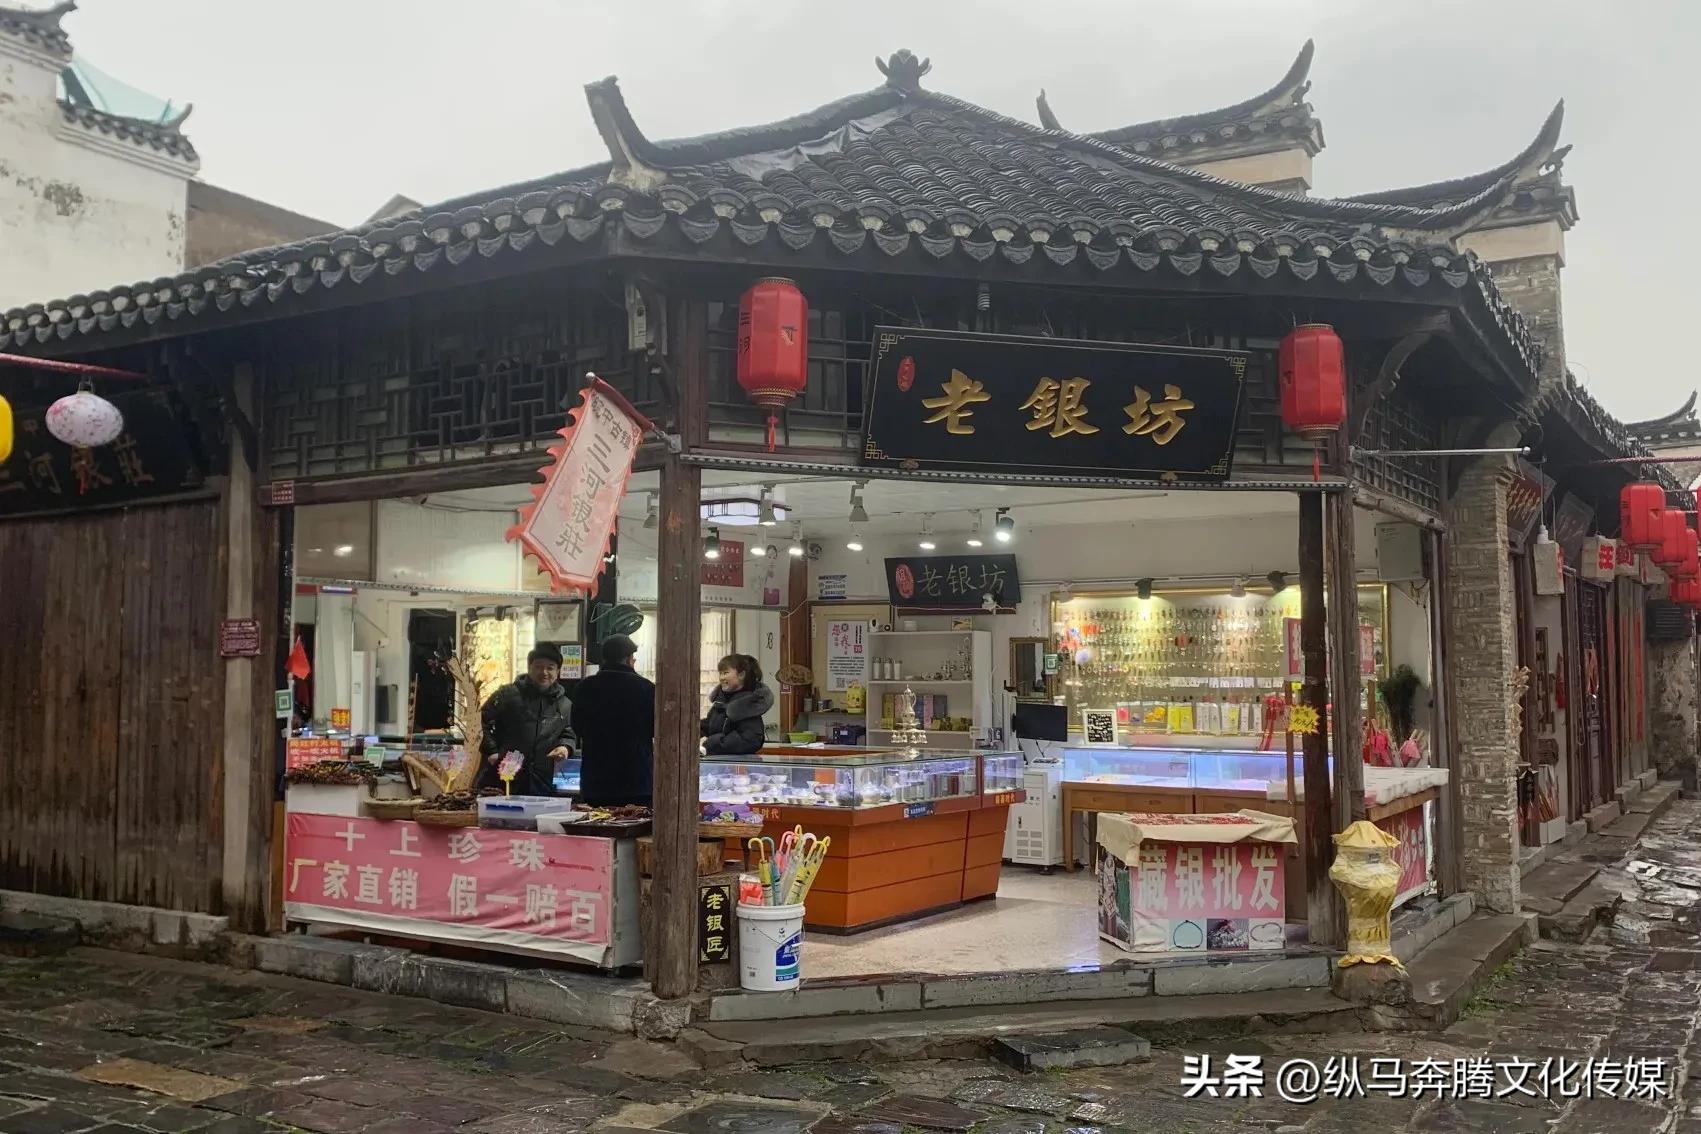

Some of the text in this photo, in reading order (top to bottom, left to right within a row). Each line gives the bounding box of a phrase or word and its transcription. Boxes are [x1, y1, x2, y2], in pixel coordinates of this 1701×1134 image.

[922, 368, 1195, 446] 老銀坊
[917, 563, 1007, 597] 老银坊
[289, 858, 417, 910] 厂家直销
[448, 873, 602, 935] 假一赔百
[1137, 845, 1280, 912] 藏银批发
